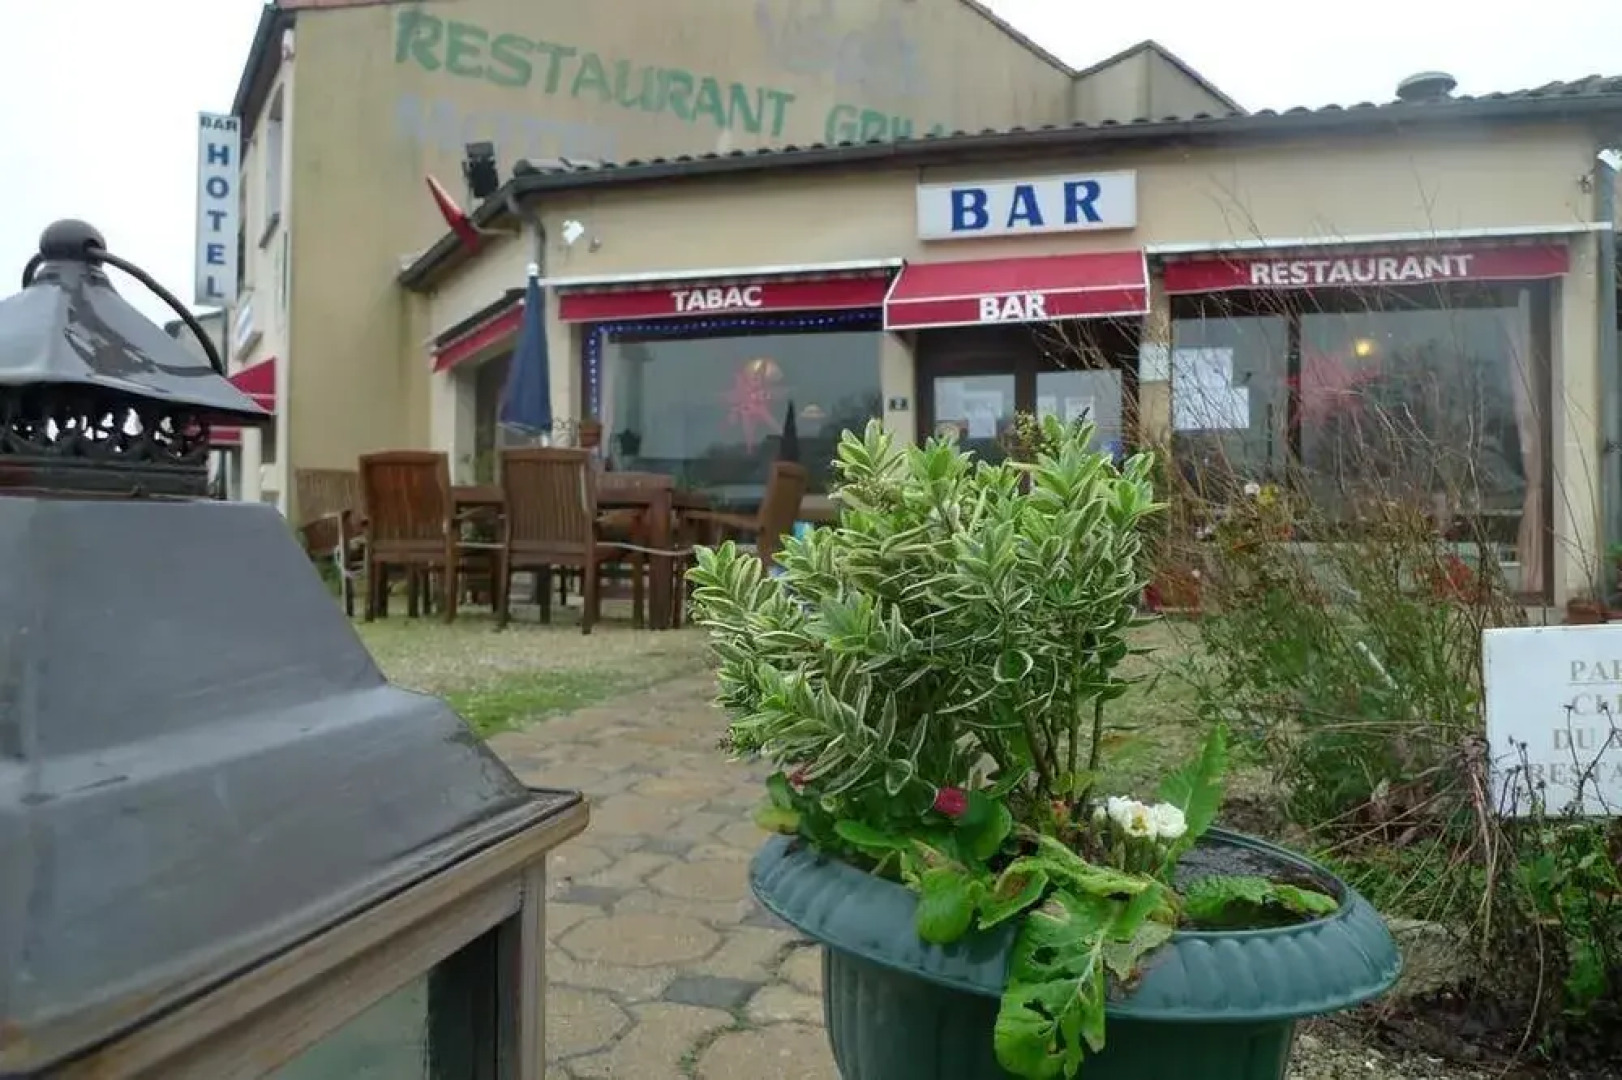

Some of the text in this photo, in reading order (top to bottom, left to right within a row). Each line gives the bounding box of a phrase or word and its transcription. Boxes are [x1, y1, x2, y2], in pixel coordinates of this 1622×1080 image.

[393, 9, 796, 139] RESTAURANT
[201, 116, 237, 132] BAR
[206, 143, 229, 298] HOTEL
[951, 180, 1103, 232] BAR
[1250, 253, 1474, 286] RESTAURANT
[671, 286, 762, 312] TABAC
[979, 293, 1048, 321] BAR
